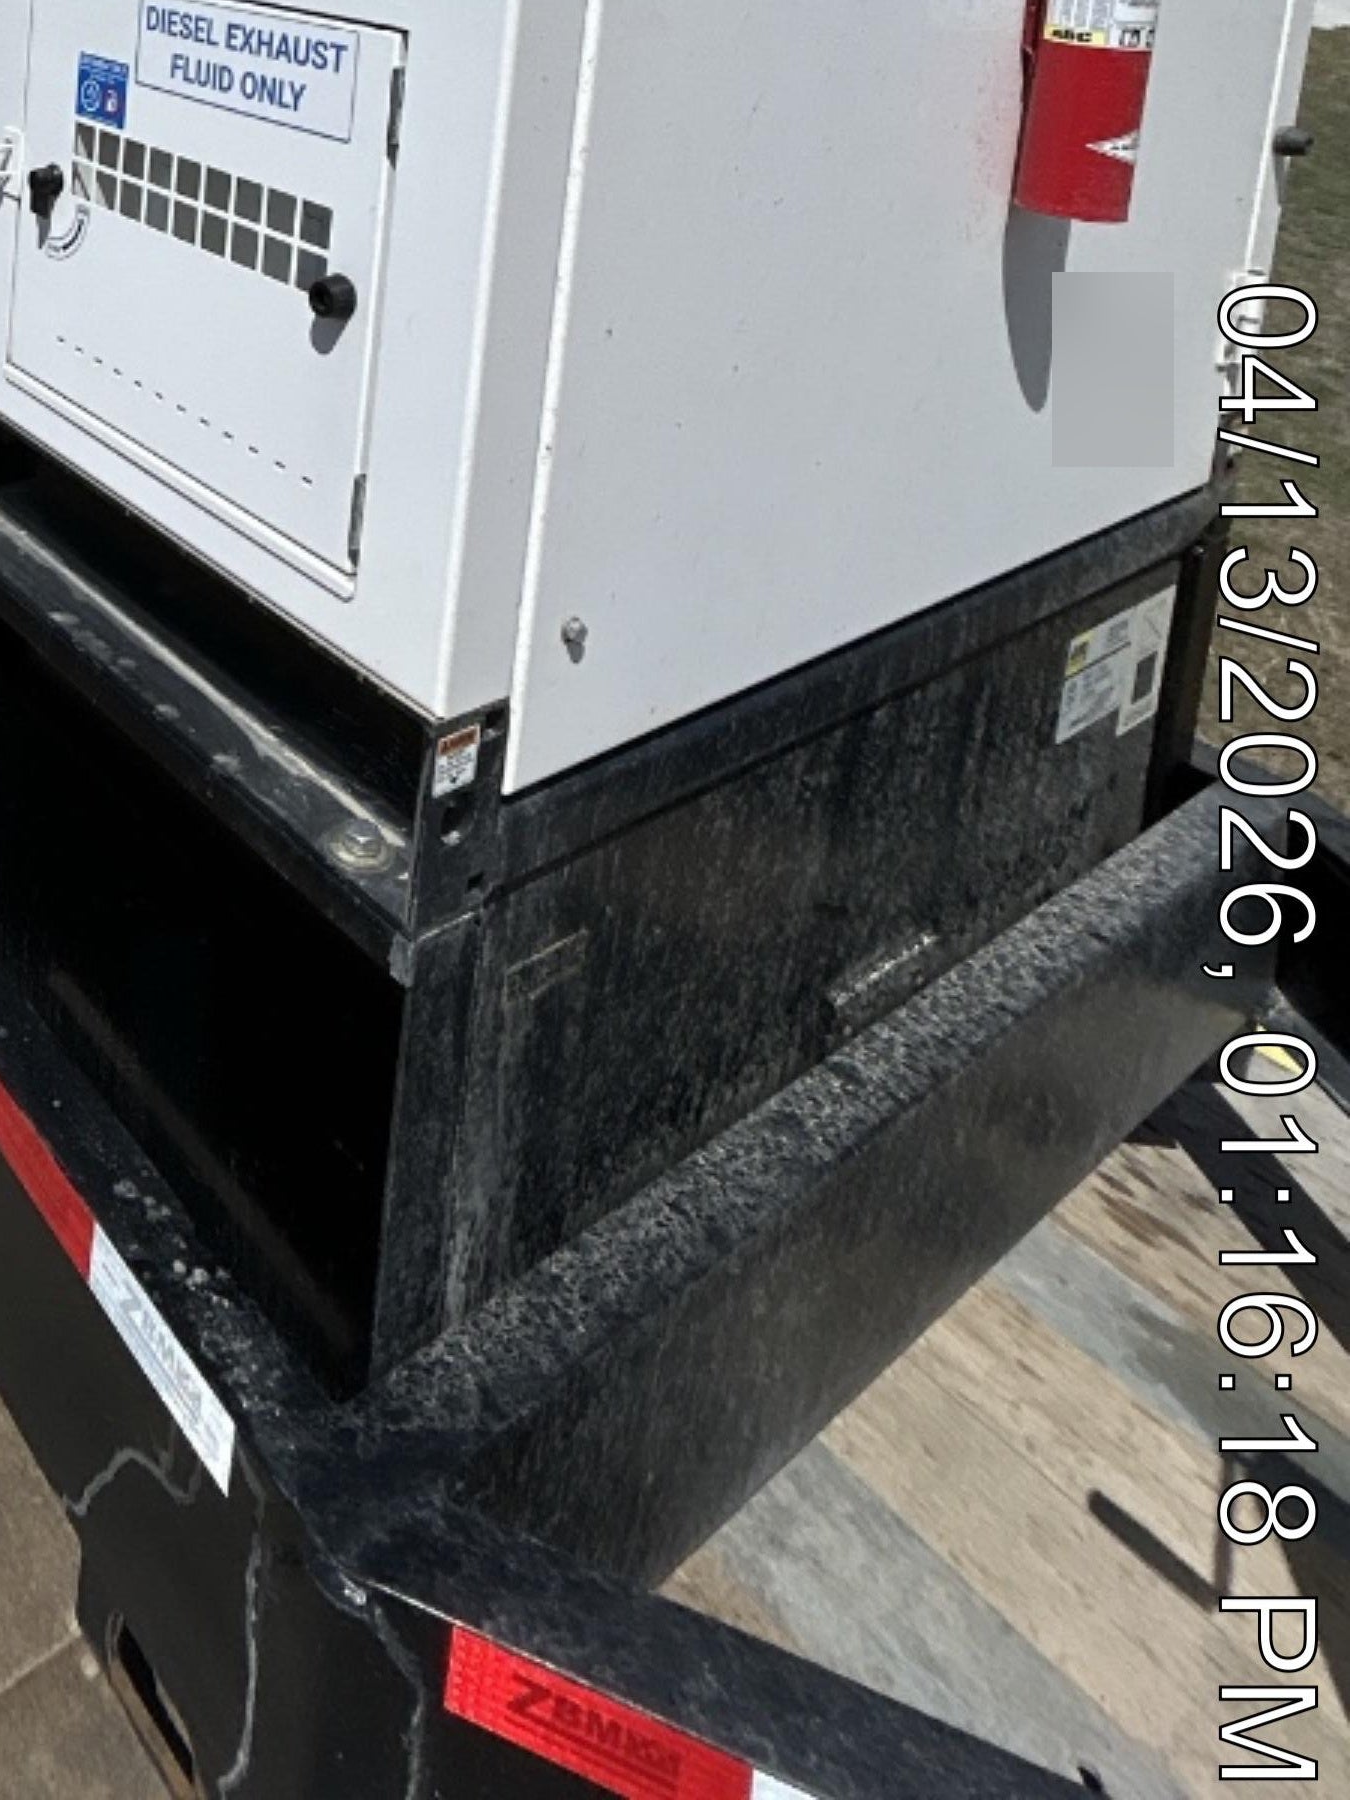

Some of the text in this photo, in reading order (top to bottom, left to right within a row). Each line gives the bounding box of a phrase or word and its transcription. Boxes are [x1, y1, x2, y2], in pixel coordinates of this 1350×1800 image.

[146, 5, 348, 75] DIESEL EXHAUST
[170, 53, 233, 92] FLUID
[241, 69, 307, 112] ONLY
